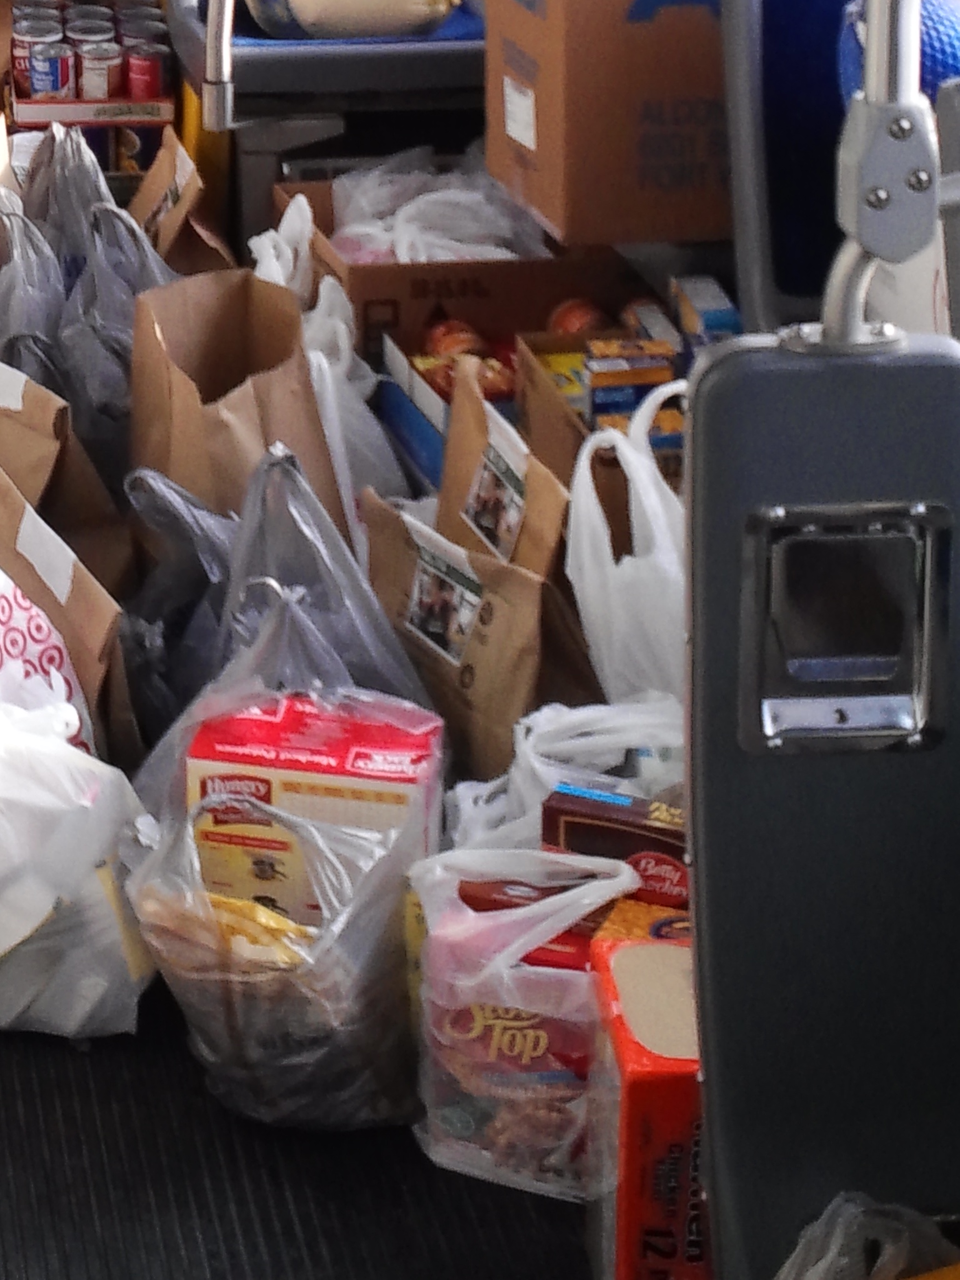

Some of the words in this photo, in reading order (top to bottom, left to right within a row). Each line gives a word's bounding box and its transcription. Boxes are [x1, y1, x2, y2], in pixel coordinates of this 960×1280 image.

[206, 777, 269, 796] Hungry
[640, 858, 681, 884] Betty
[487, 1019, 549, 1065] Top
[643, 1228, 678, 1261] 12
